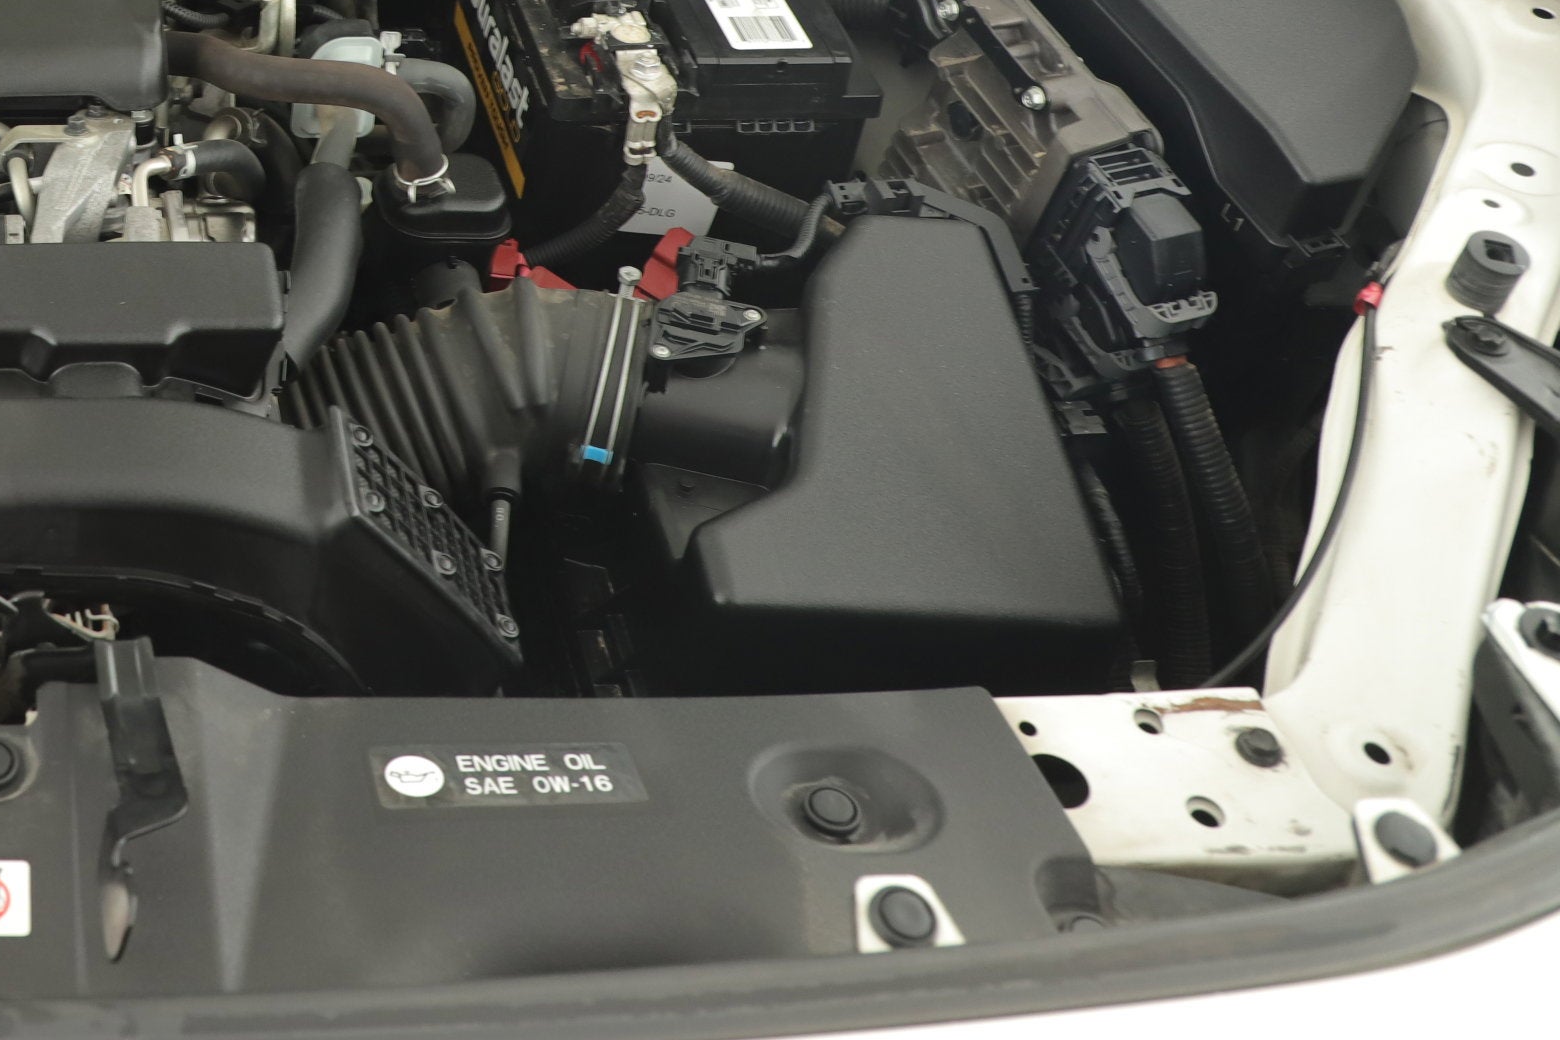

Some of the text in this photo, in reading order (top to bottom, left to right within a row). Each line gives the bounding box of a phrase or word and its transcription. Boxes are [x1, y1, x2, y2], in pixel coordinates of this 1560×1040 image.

[646, 173, 673, 184] 9/24
[455, 753, 607, 773] ENGINE OIL
[464, 775, 614, 795] SAE 0W-16
